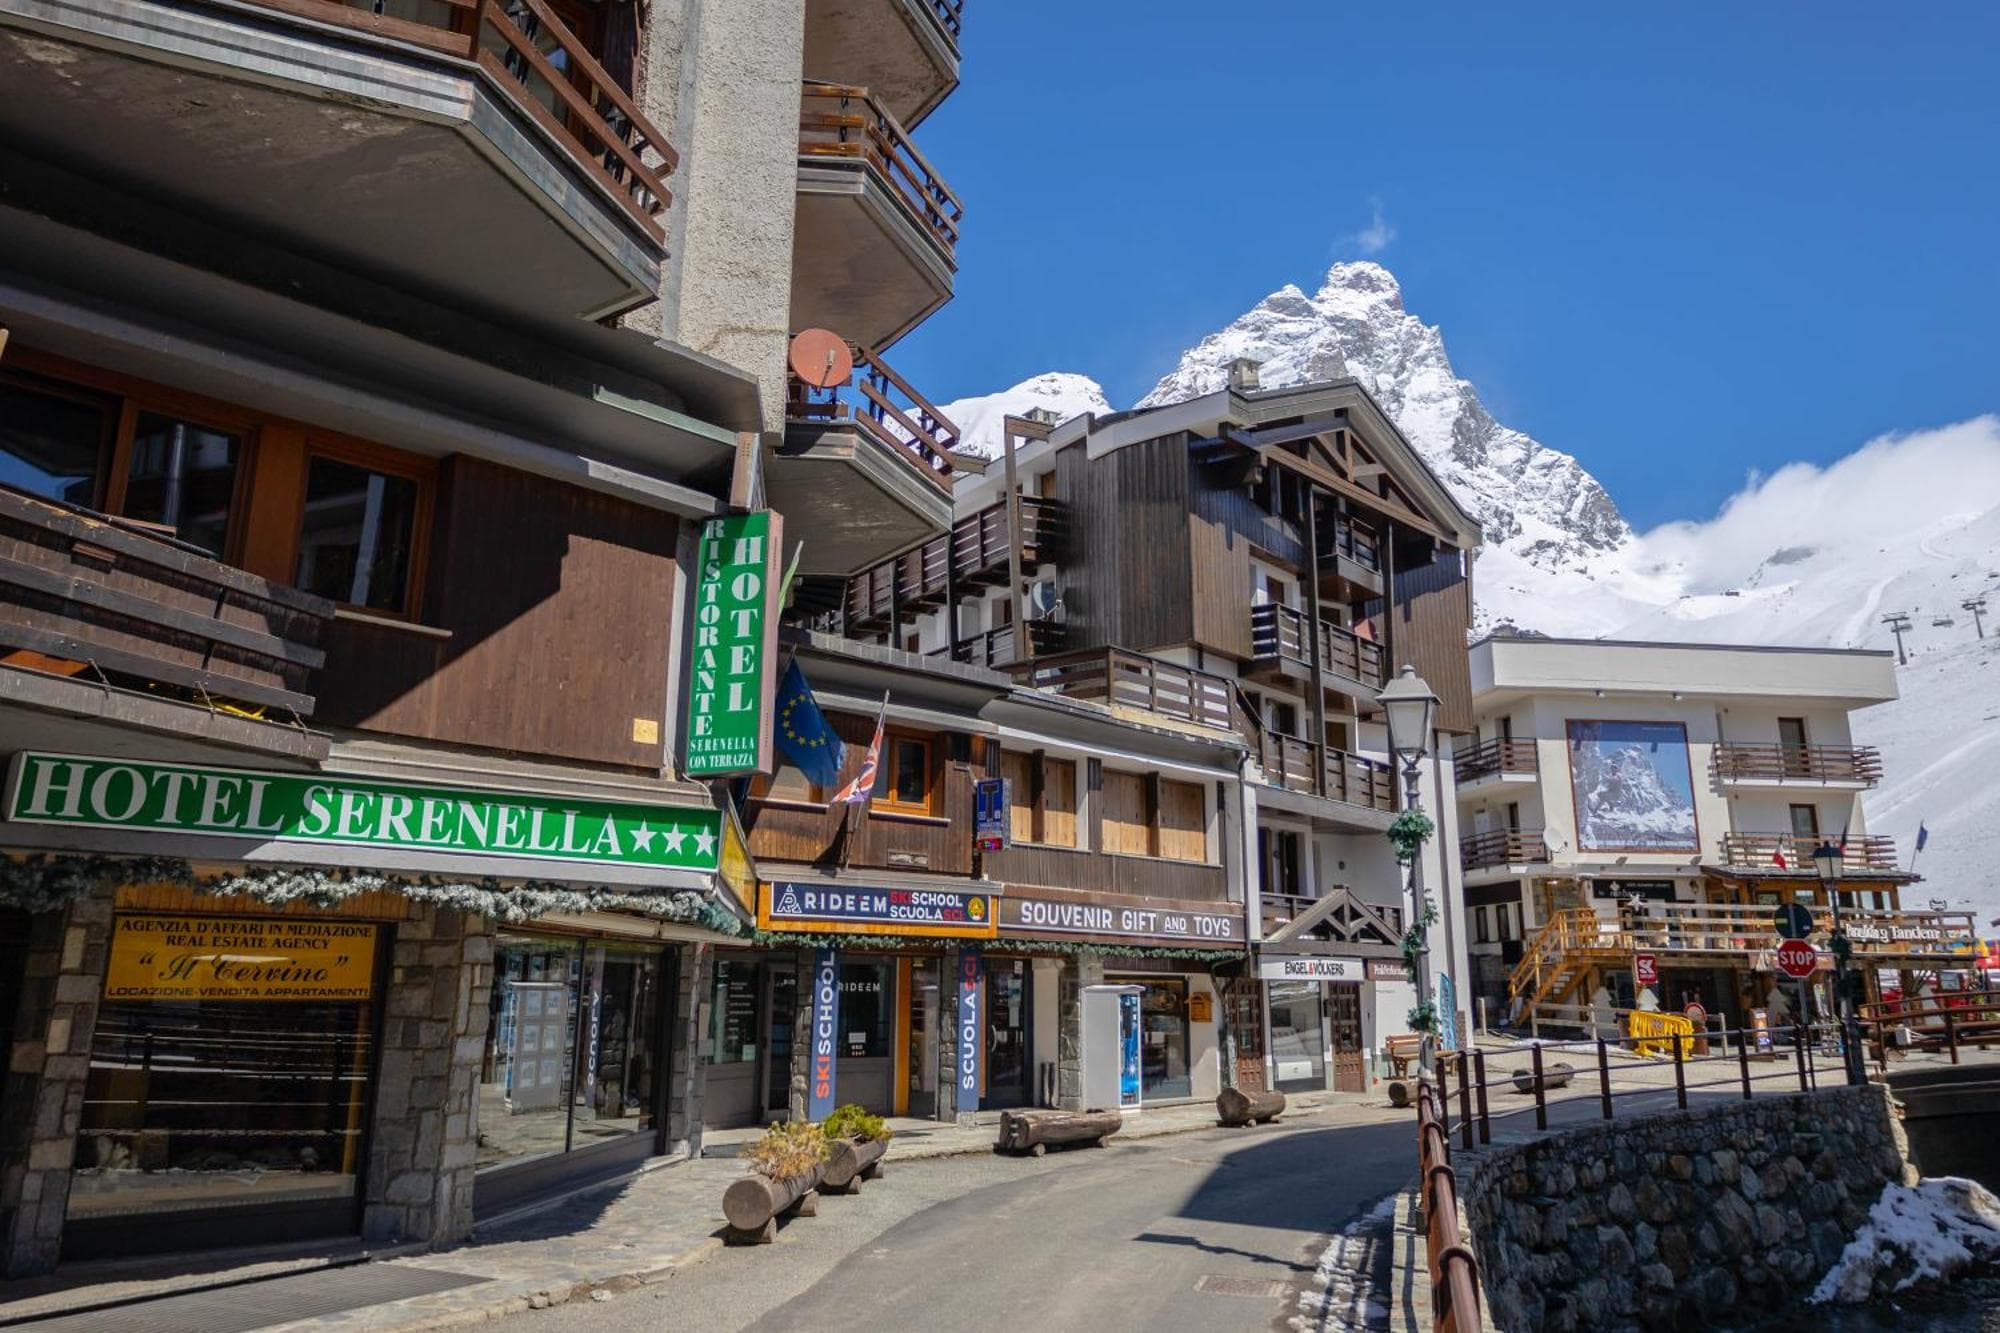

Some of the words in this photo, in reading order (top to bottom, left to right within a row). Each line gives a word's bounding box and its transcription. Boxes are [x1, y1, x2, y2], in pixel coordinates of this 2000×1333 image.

[695, 519, 725, 736] RISTORANTE
[728, 535, 763, 713] HOTEL
[690, 737, 754, 752] SERENELLA
[24, 759, 285, 831] HOTEL
[297, 785, 622, 856] SERENELLA
[120, 920, 192, 933] AGENZIA
[268, 924, 283, 935] IN
[288, 925, 373, 938] MEDIAZIONE
[1021, 902, 1113, 929] SOUVENIR
[1121, 910, 1157, 932] GIFT
[1164, 916, 1188, 933] AND
[1194, 916, 1231, 937] TOYS
[166, 935, 207, 947] REAL
[212, 936, 267, 949] ESTATE
[272, 938, 331, 950] AGENCY
[1779, 950, 1814, 966] STOP
